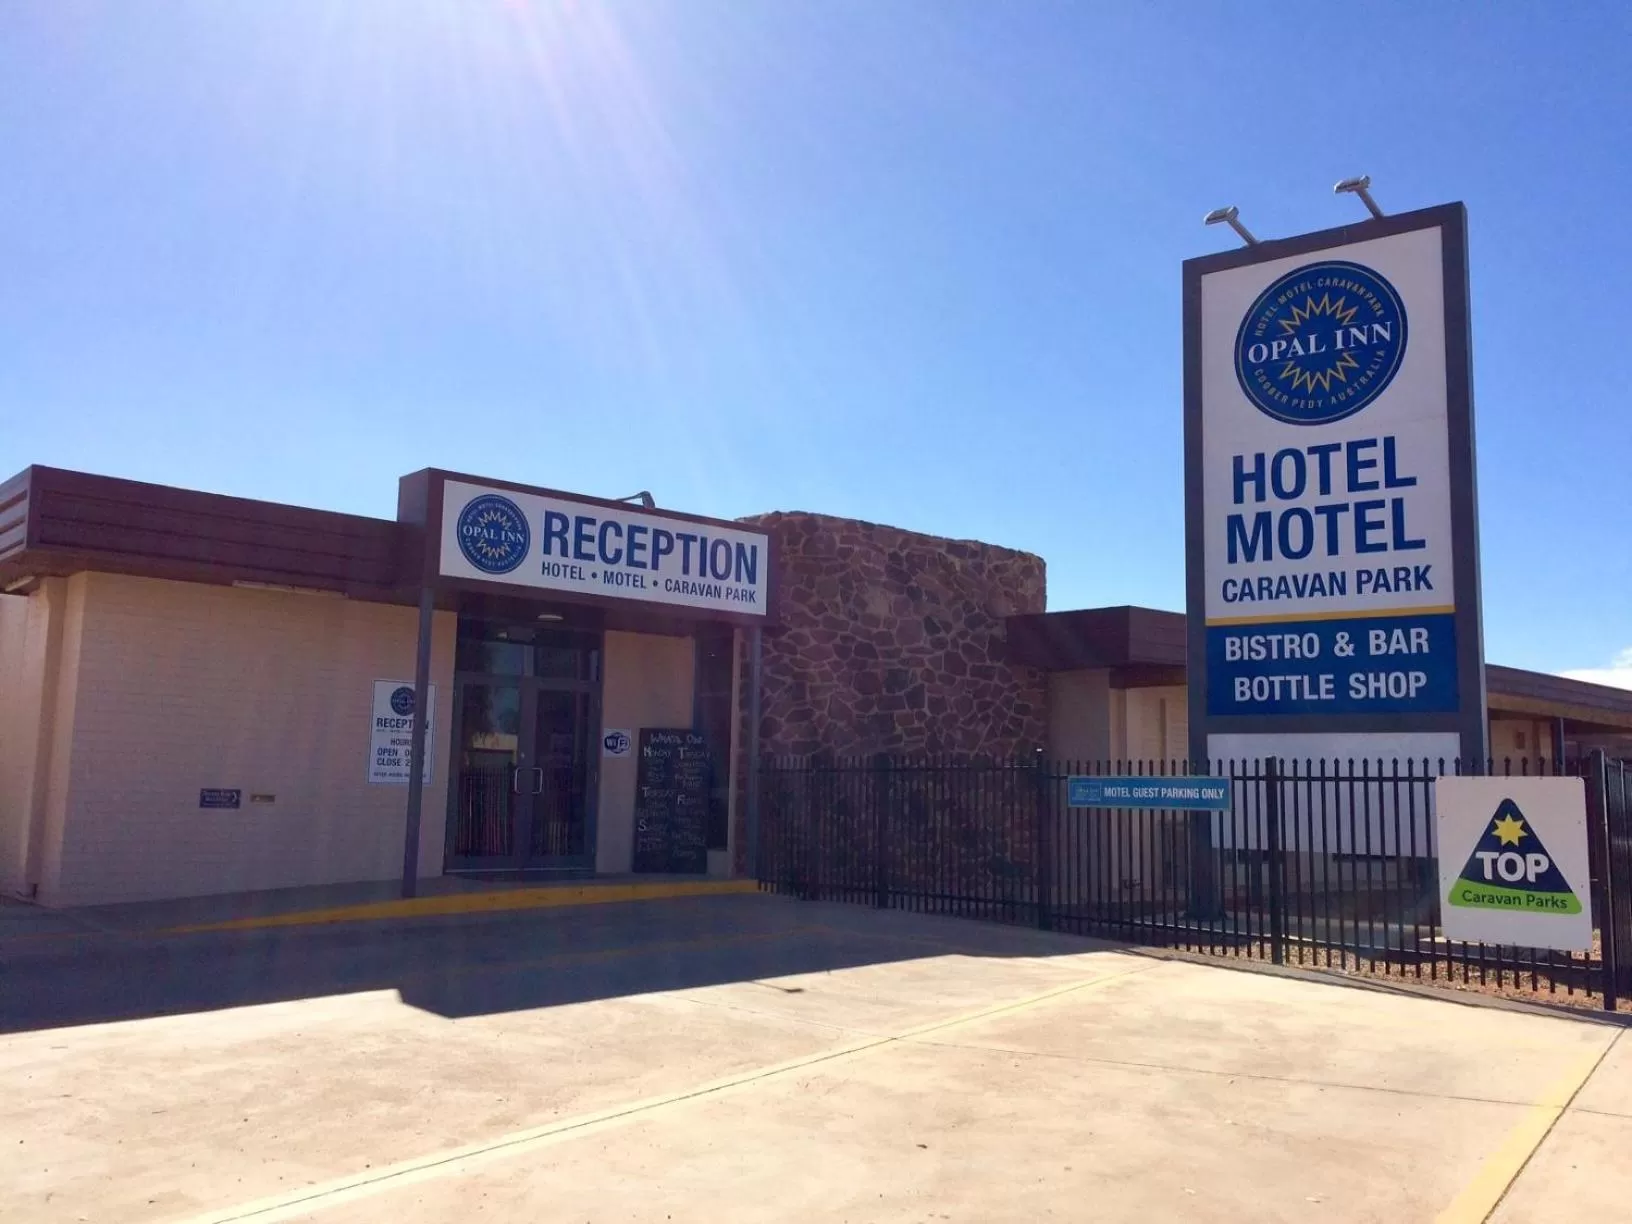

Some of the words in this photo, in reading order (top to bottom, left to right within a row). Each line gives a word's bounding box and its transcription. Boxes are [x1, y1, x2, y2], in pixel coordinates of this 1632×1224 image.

[1255, 305, 1278, 337] HOTEL
[1278, 280, 1313, 306] MOTEL
[1317, 277, 1367, 297] CARAVAN
[1364, 291, 1385, 317] PARK
[1248, 332, 1326, 364] OPAL
[1334, 321, 1393, 351] INN
[1254, 367, 1289, 404] COOBER
[1291, 397, 1324, 409] PEDY
[1330, 349, 1387, 405] AUSTRALIA
[1232, 436, 1417, 504] HOTEL
[463, 525, 498, 540] OPAL
[501, 531, 524, 543] INN
[543, 509, 758, 585] RECEPTION
[1227, 497, 1426, 564] MOTEL
[541, 561, 586, 581] HOTEL
[603, 569, 647, 589] MOTEL
[665, 578, 722, 599] CARAVAN
[726, 587, 757, 604] PARK
[1222, 571, 1347, 603] CARAVAN
[1356, 564, 1433, 595] PARK
[1225, 632, 1320, 661] BISTRO
[1334, 631, 1355, 657] &
[1368, 627, 1430, 656] BAR
[1234, 674, 1336, 701] BOTTLE
[1349, 671, 1427, 699] SHOP
[376, 757, 401, 767] CLOSE
[377, 747, 398, 757] OPEN
[1104, 786, 1130, 798] MOTEL
[1132, 787, 1158, 798] GUEST
[1161, 787, 1199, 799] PARKING
[1202, 788, 1225, 800] ONLY
[1475, 851, 1549, 883] TOP
[1462, 889, 1522, 907] Caravan
[1526, 894, 1568, 909] Parks
